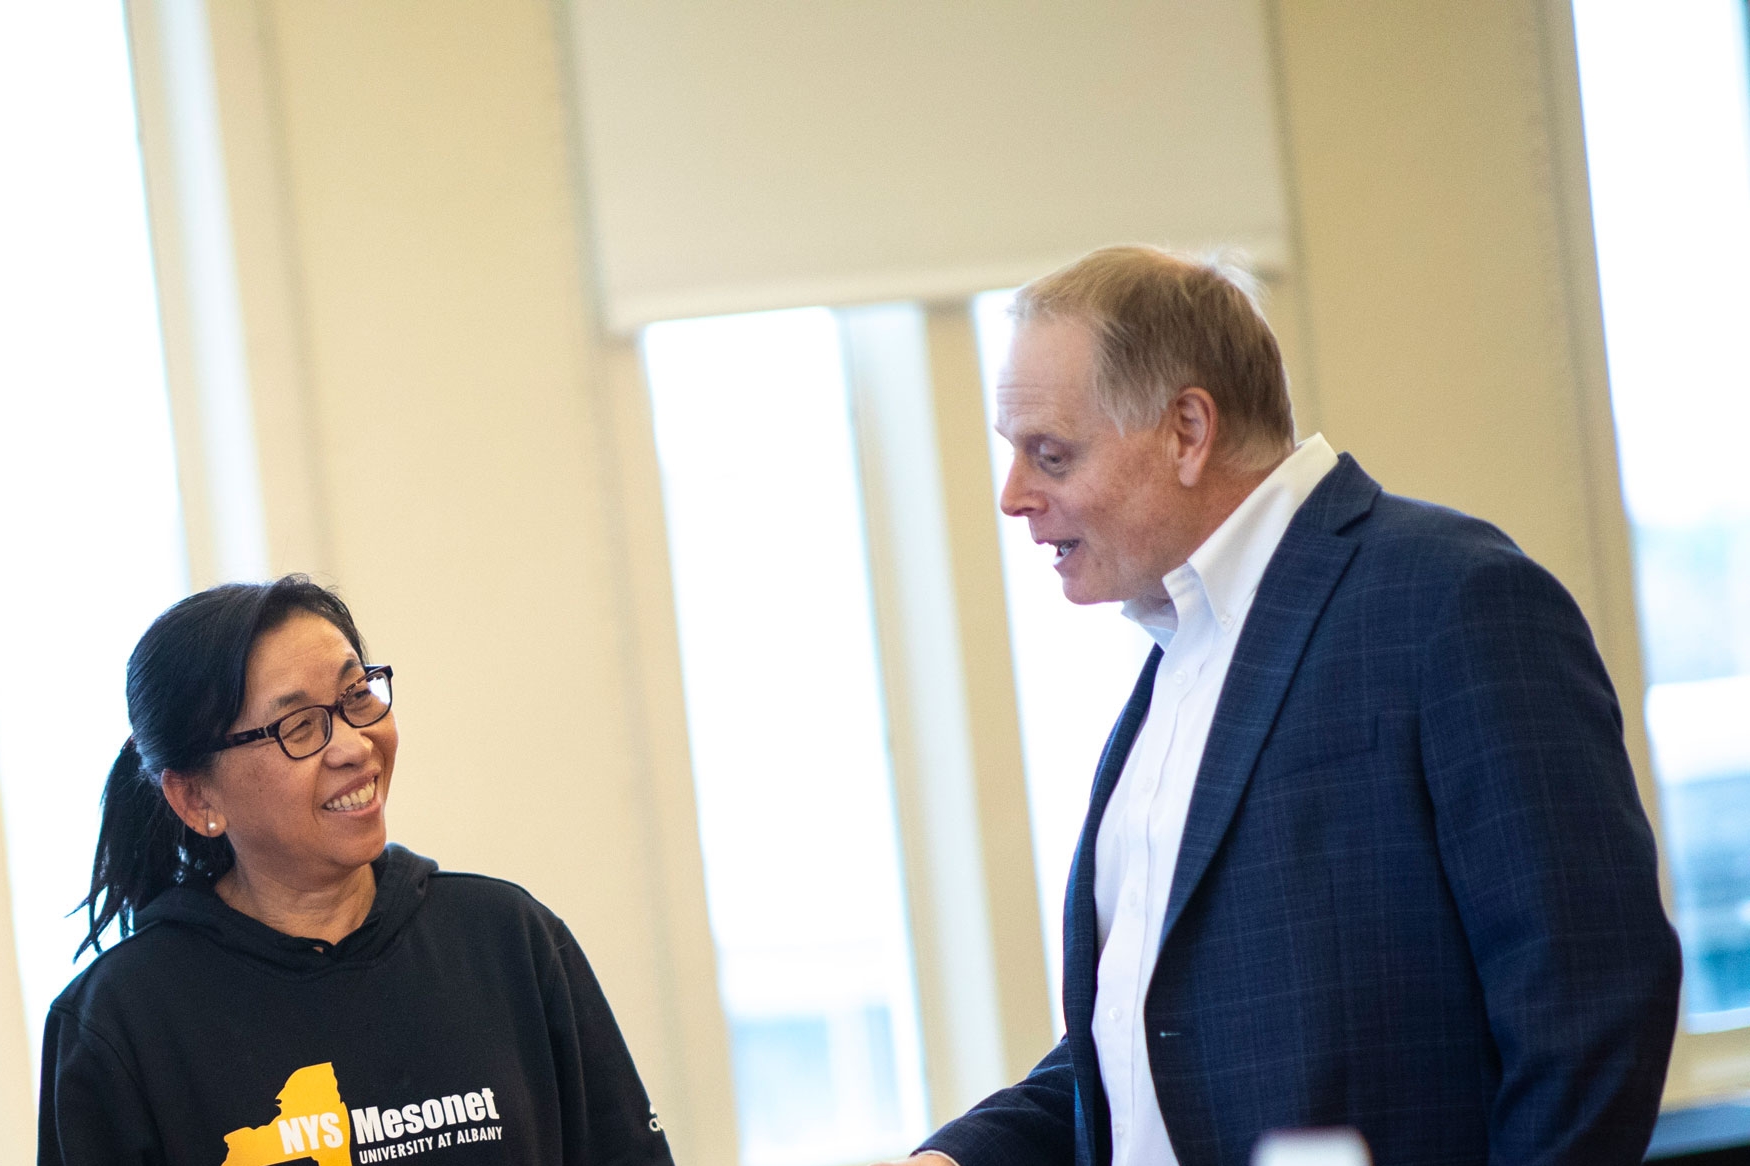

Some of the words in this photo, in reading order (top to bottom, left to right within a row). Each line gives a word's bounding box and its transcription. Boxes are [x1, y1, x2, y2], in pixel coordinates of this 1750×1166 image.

[277, 1111, 344, 1155] NYS
[350, 1087, 500, 1145] Mesonet
[358, 1136, 434, 1165] UNIVERSITY
[437, 1132, 452, 1149] AT
[456, 1126, 503, 1145] ALBANY
